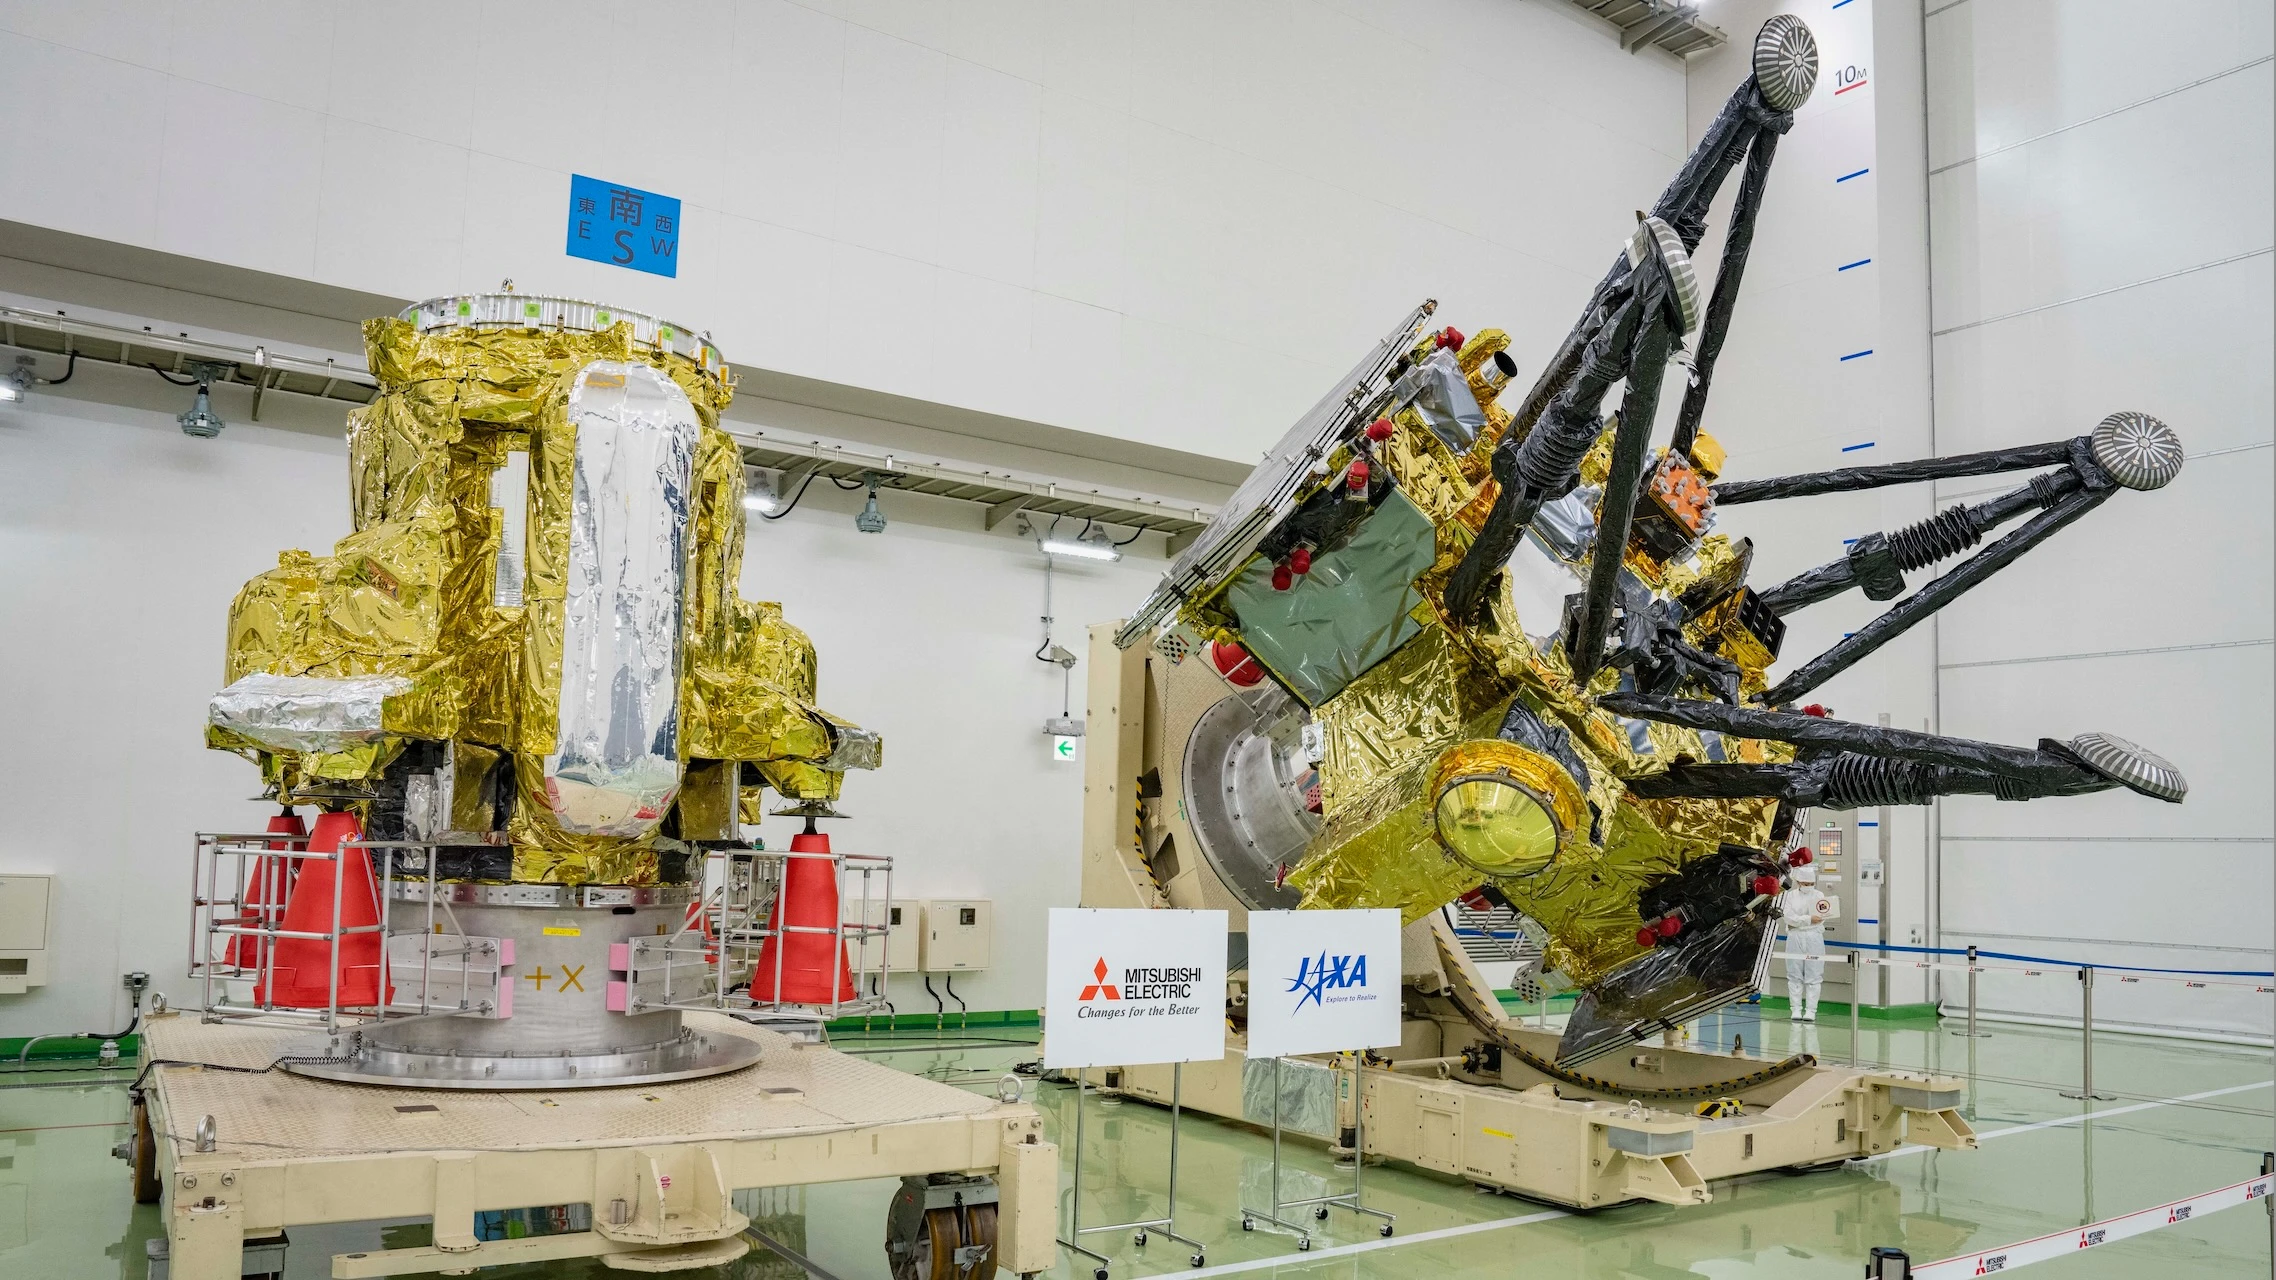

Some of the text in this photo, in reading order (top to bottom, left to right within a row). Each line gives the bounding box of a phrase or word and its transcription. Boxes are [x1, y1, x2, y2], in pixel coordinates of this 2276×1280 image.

[578, 189, 673, 234] 東 南 西
[579, 220, 675, 264] E S W
[1125, 967, 1201, 984] MITSUBISHI
[1281, 949, 1367, 1010] JAXA
[1125, 983, 1191, 1000] ELECTRIC
[1325, 995, 1348, 1004] Explore
[1356, 993, 1377, 1001] Realize
[1078, 1003, 1200, 1020] Changes for the Better
